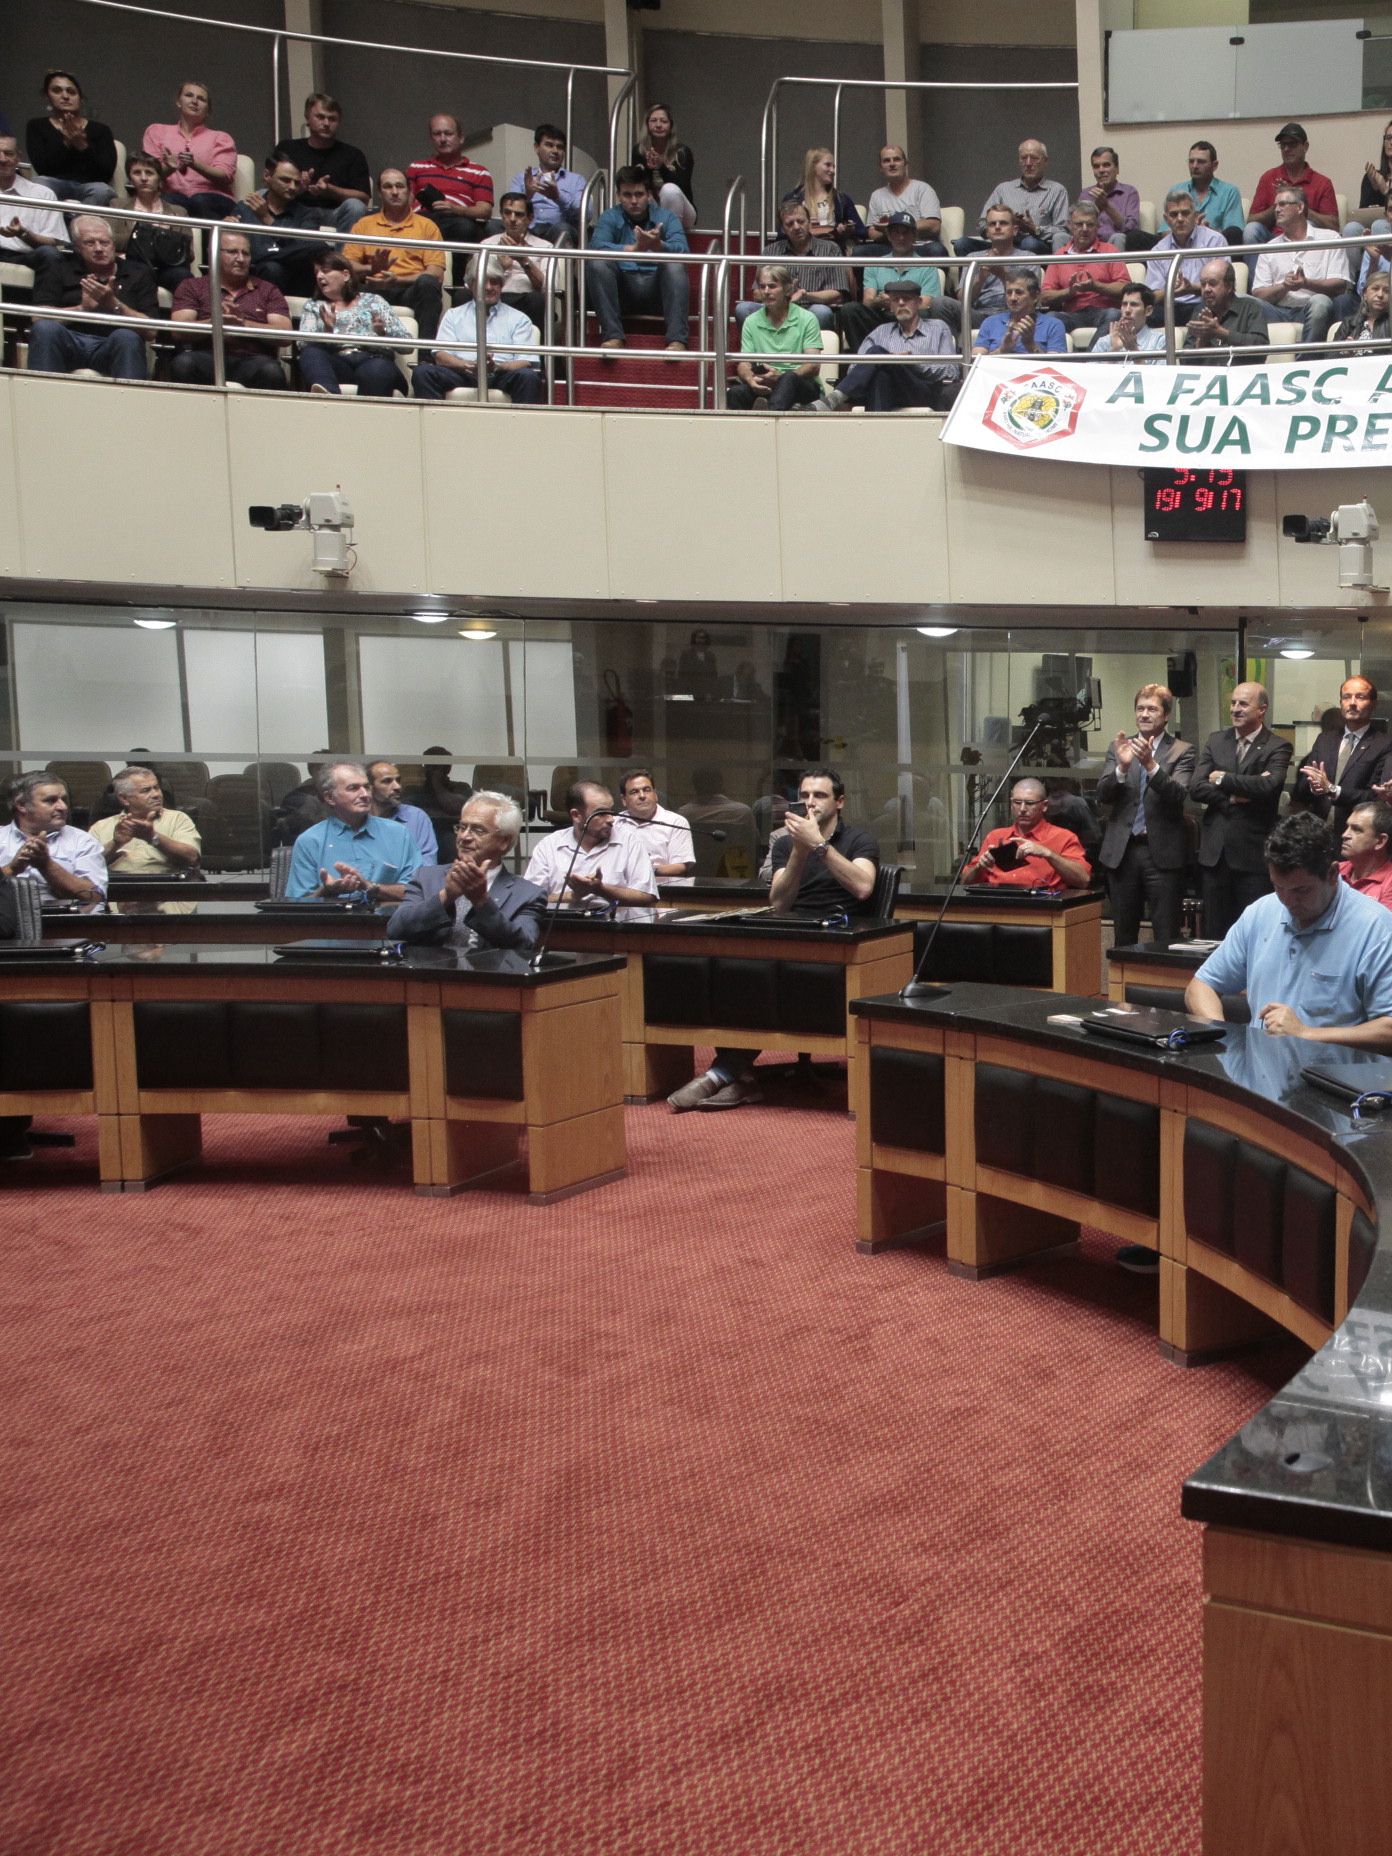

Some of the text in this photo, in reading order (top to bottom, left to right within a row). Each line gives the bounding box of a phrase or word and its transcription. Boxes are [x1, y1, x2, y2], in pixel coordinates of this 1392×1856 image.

[1105, 371, 1145, 404] A
[1166, 366, 1349, 406] FAASC
[1138, 412, 1251, 455] SUA
